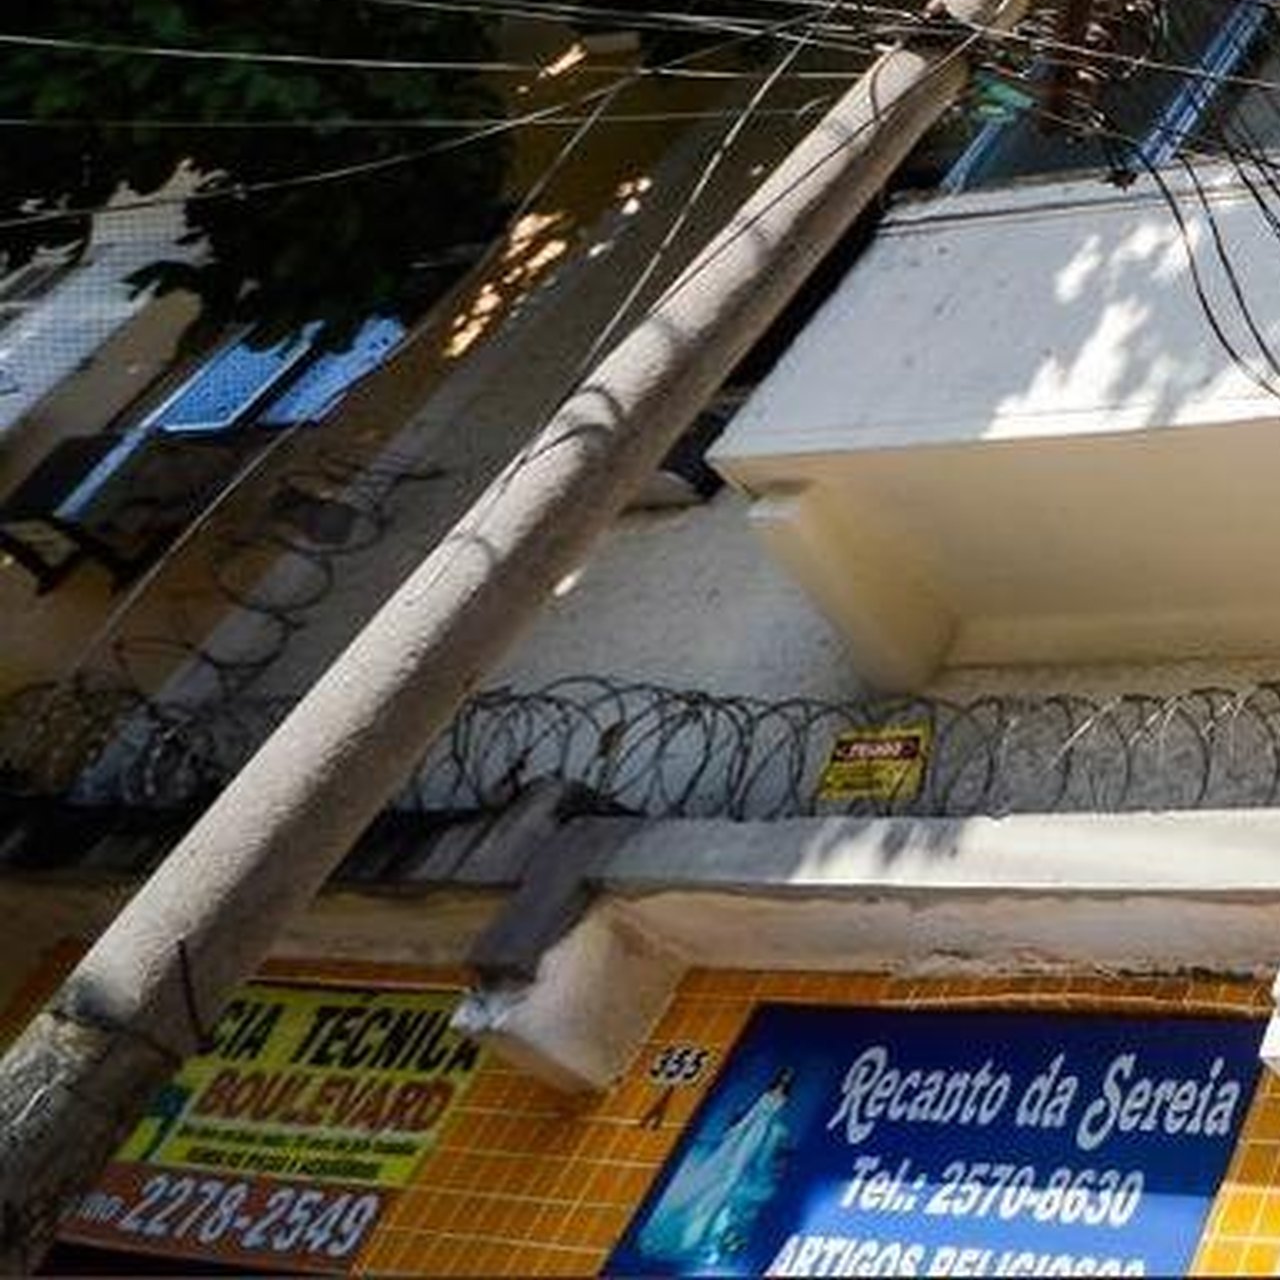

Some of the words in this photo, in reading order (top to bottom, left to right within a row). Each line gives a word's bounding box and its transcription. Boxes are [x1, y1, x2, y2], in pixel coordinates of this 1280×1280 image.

[290, 993, 480, 1071] TÉCNICA
[200, 1069, 457, 1132] BOULEVARD
[827, 1046, 1011, 1145] Recanto
[1016, 1053, 1079, 1128] da
[1076, 1054, 1241, 1151] Sereia
[120, 1173, 380, 1257] 2278-2549
[924, 1160, 1146, 1228] 2570-8630
[763, 1233, 925, 1276] ARTIGOS
